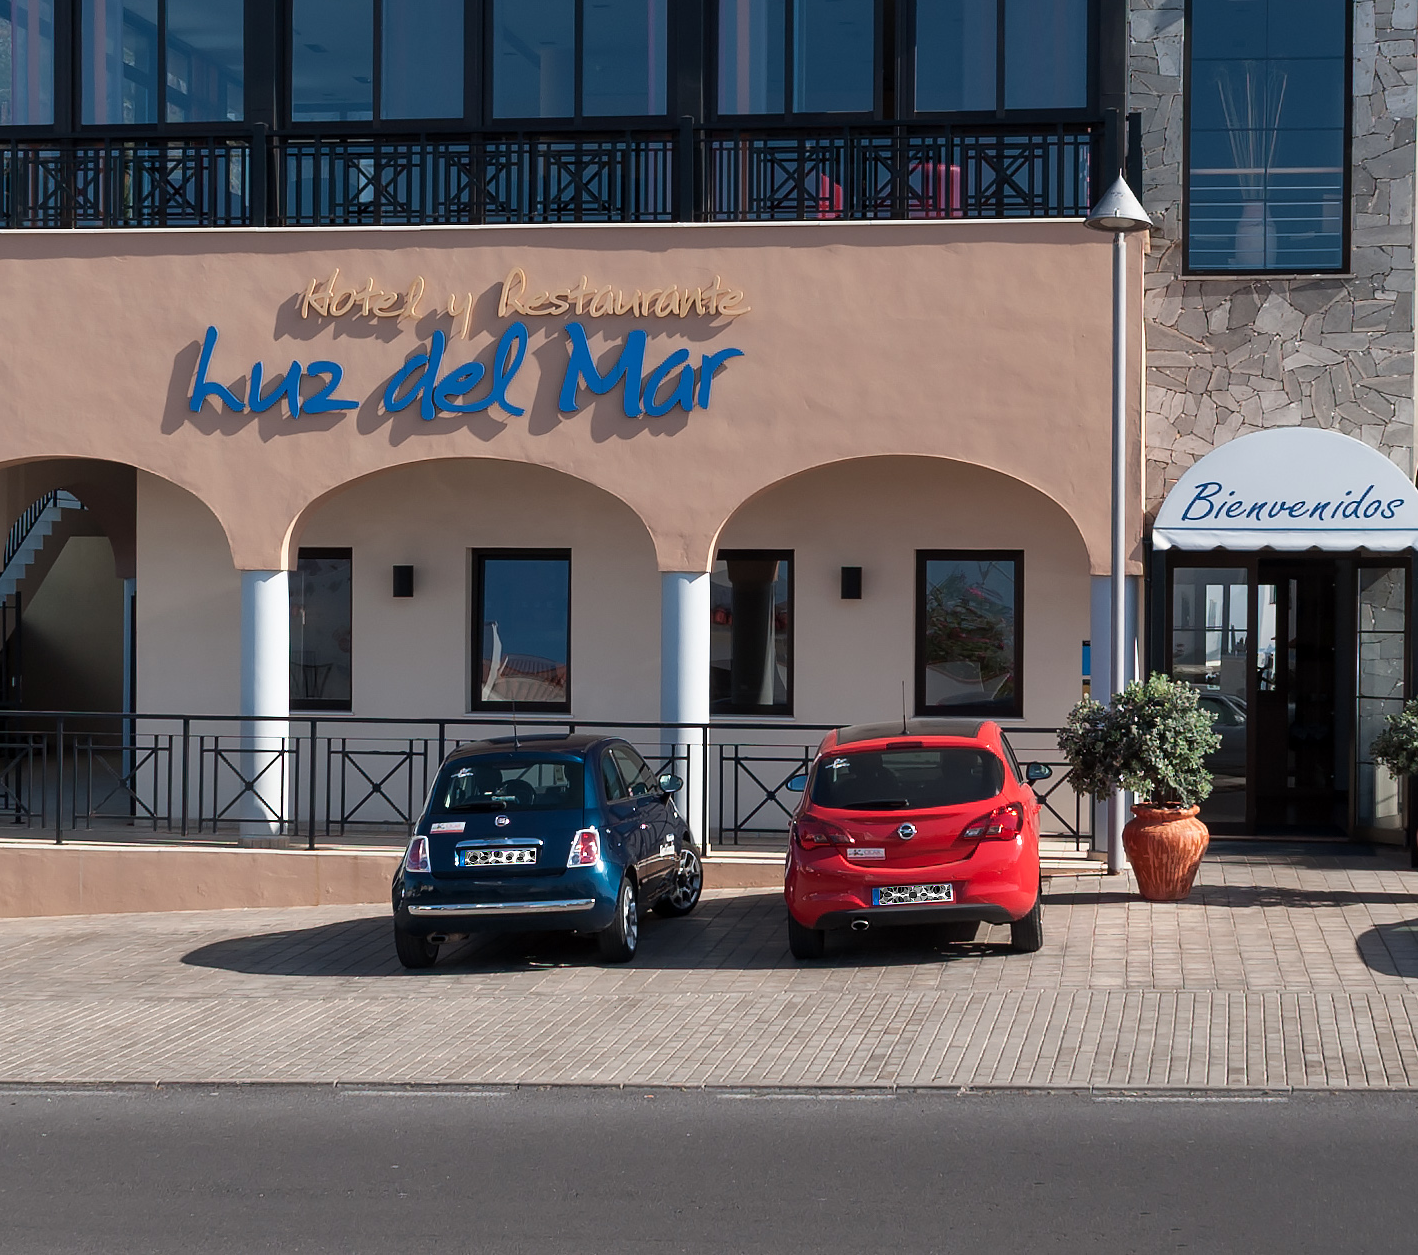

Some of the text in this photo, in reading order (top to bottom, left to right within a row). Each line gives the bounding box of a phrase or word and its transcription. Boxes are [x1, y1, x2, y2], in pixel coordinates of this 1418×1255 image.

[299, 266, 752, 340] Hotel y Restaurante
[189, 321, 744, 421] Luz del Mar
[1181, 481, 1405, 522] Bienvenidos
